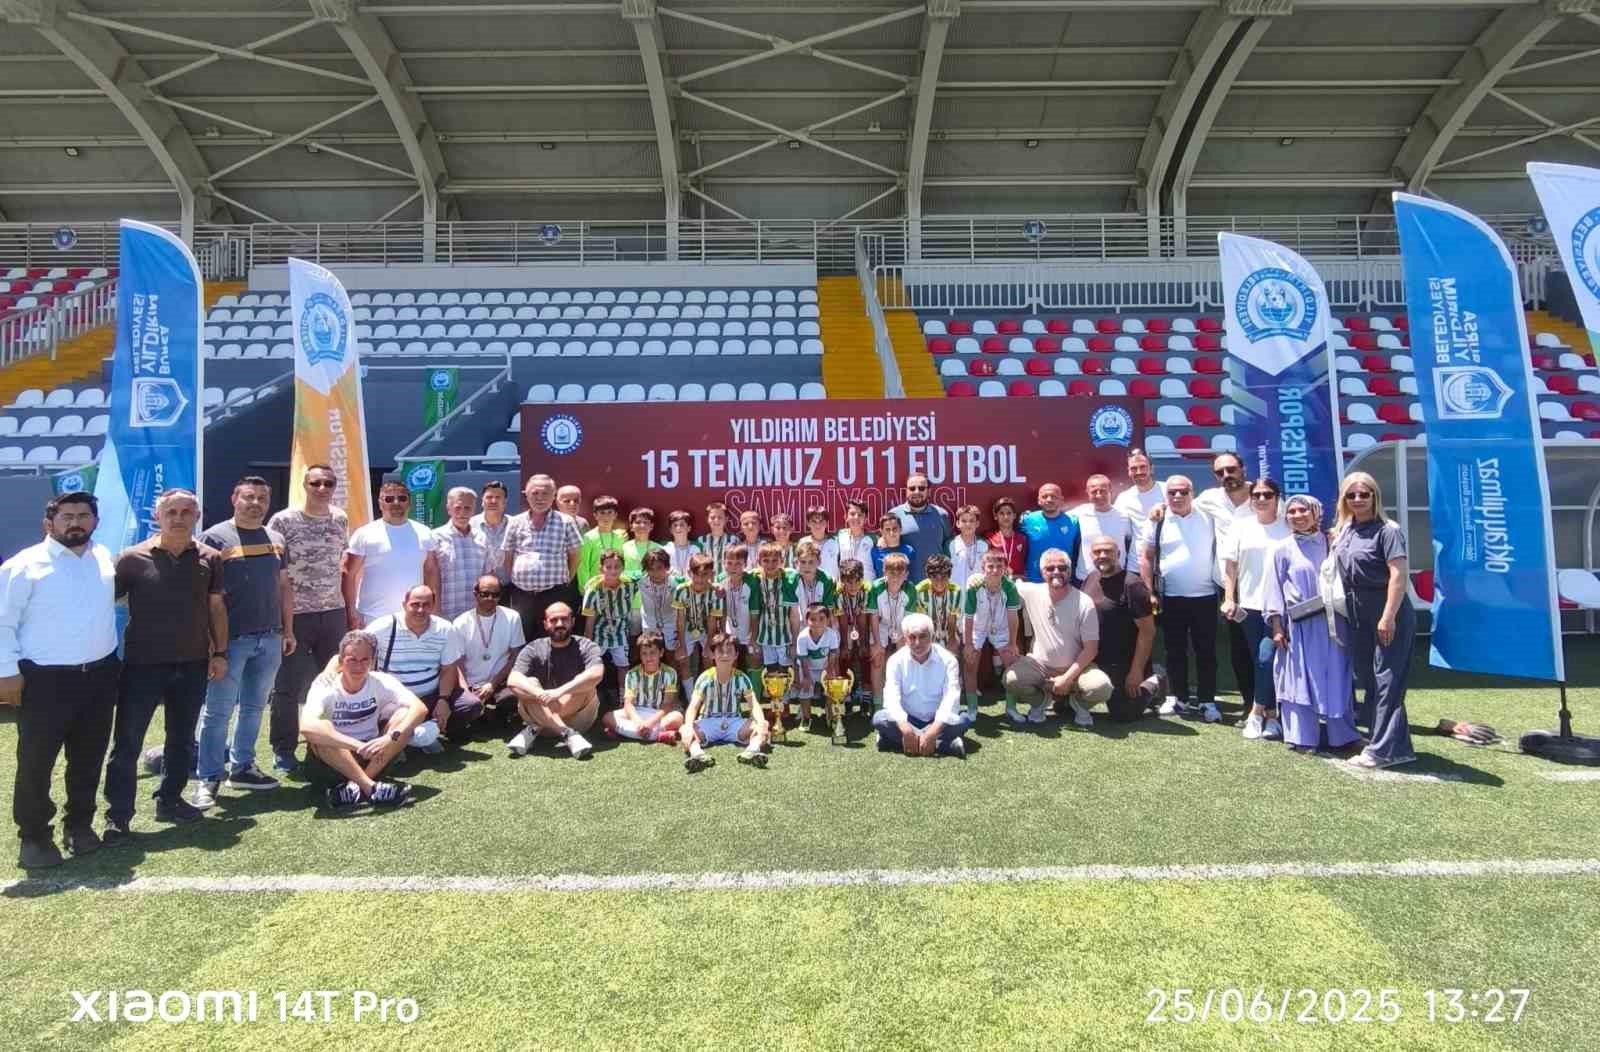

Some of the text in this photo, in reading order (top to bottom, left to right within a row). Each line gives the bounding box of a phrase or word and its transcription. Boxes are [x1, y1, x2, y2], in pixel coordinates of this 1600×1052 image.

[731, 411, 936, 443] YILDIRIM BELEDİYESİ
[641, 444, 1027, 488] 15 TEMMUZ U11 FUTBOL
